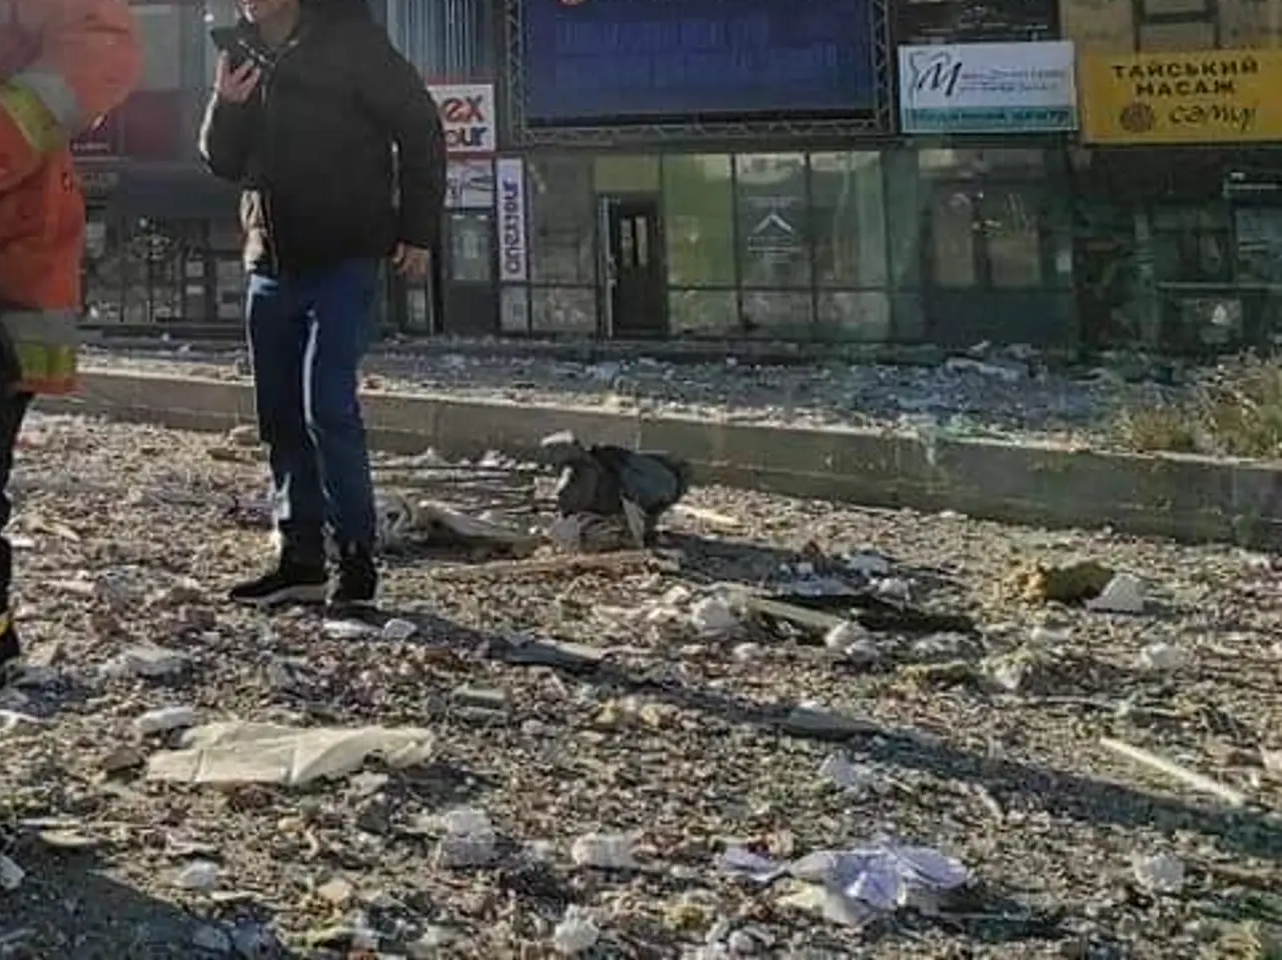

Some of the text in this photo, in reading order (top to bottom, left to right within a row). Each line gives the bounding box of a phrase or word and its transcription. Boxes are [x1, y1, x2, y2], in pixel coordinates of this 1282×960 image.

[1111, 56, 1259, 78] ТАЙСЬКИЙ
[1135, 79, 1235, 96] МАСАЖ
[442, 95, 484, 123] ex
[445, 127, 487, 147] our
